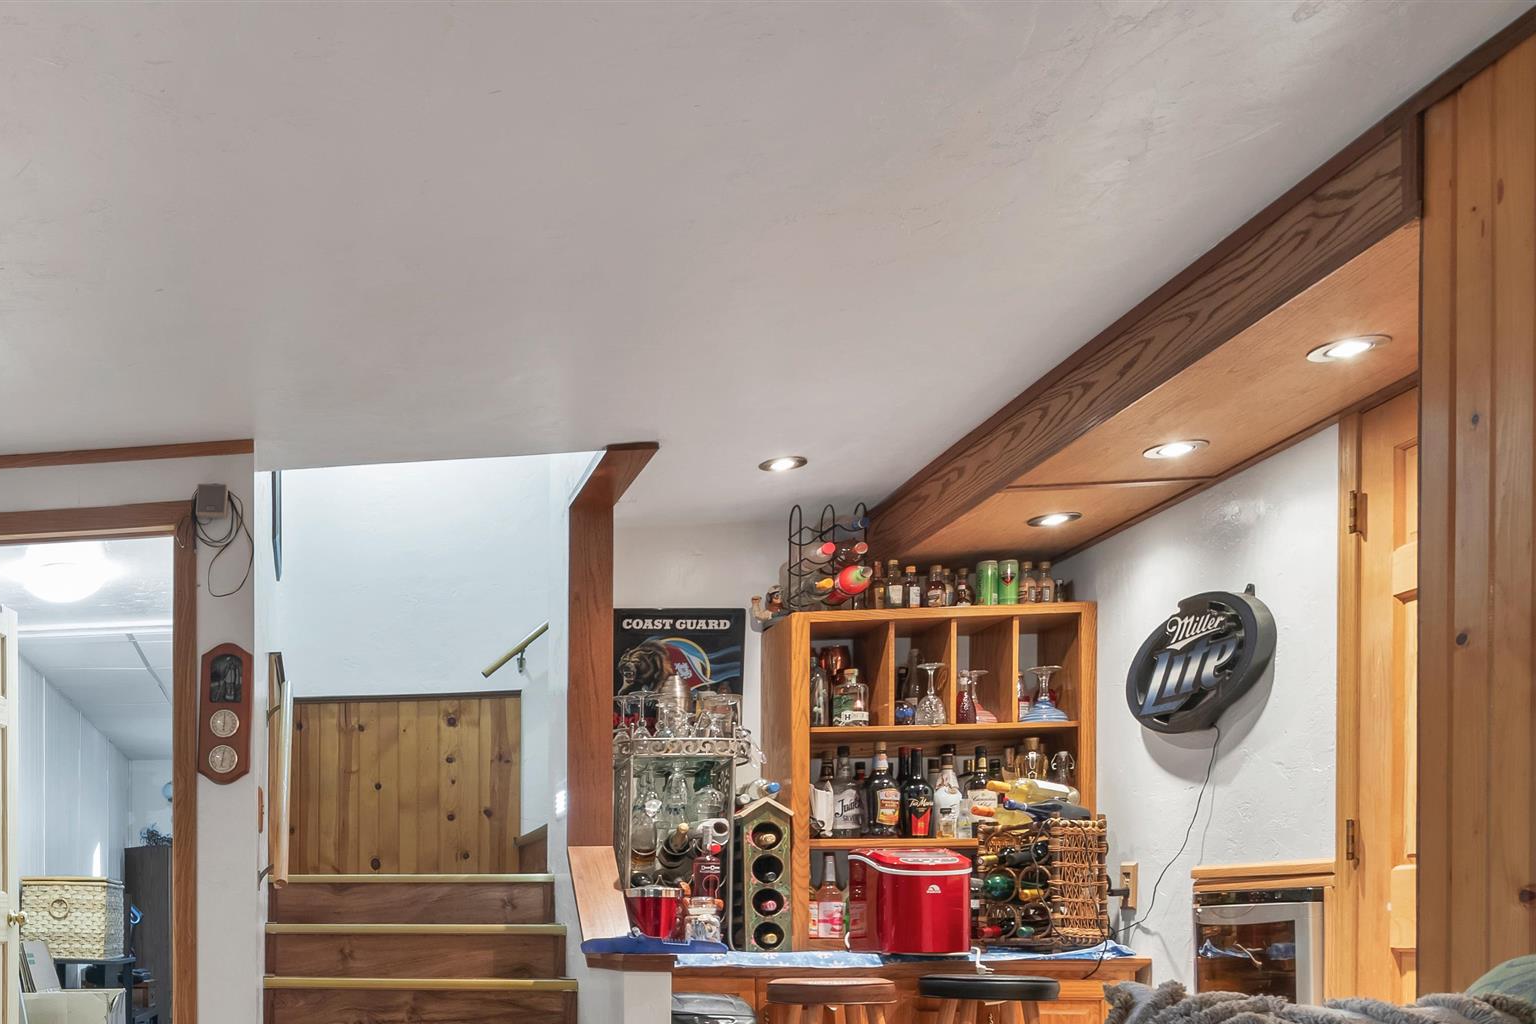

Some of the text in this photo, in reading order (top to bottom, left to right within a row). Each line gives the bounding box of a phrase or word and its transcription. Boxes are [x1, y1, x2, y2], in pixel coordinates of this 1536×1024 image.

[622, 618, 731, 630] COAST GUARD
[1166, 613, 1225, 645] Miller
[1139, 636, 1238, 716] Lite
